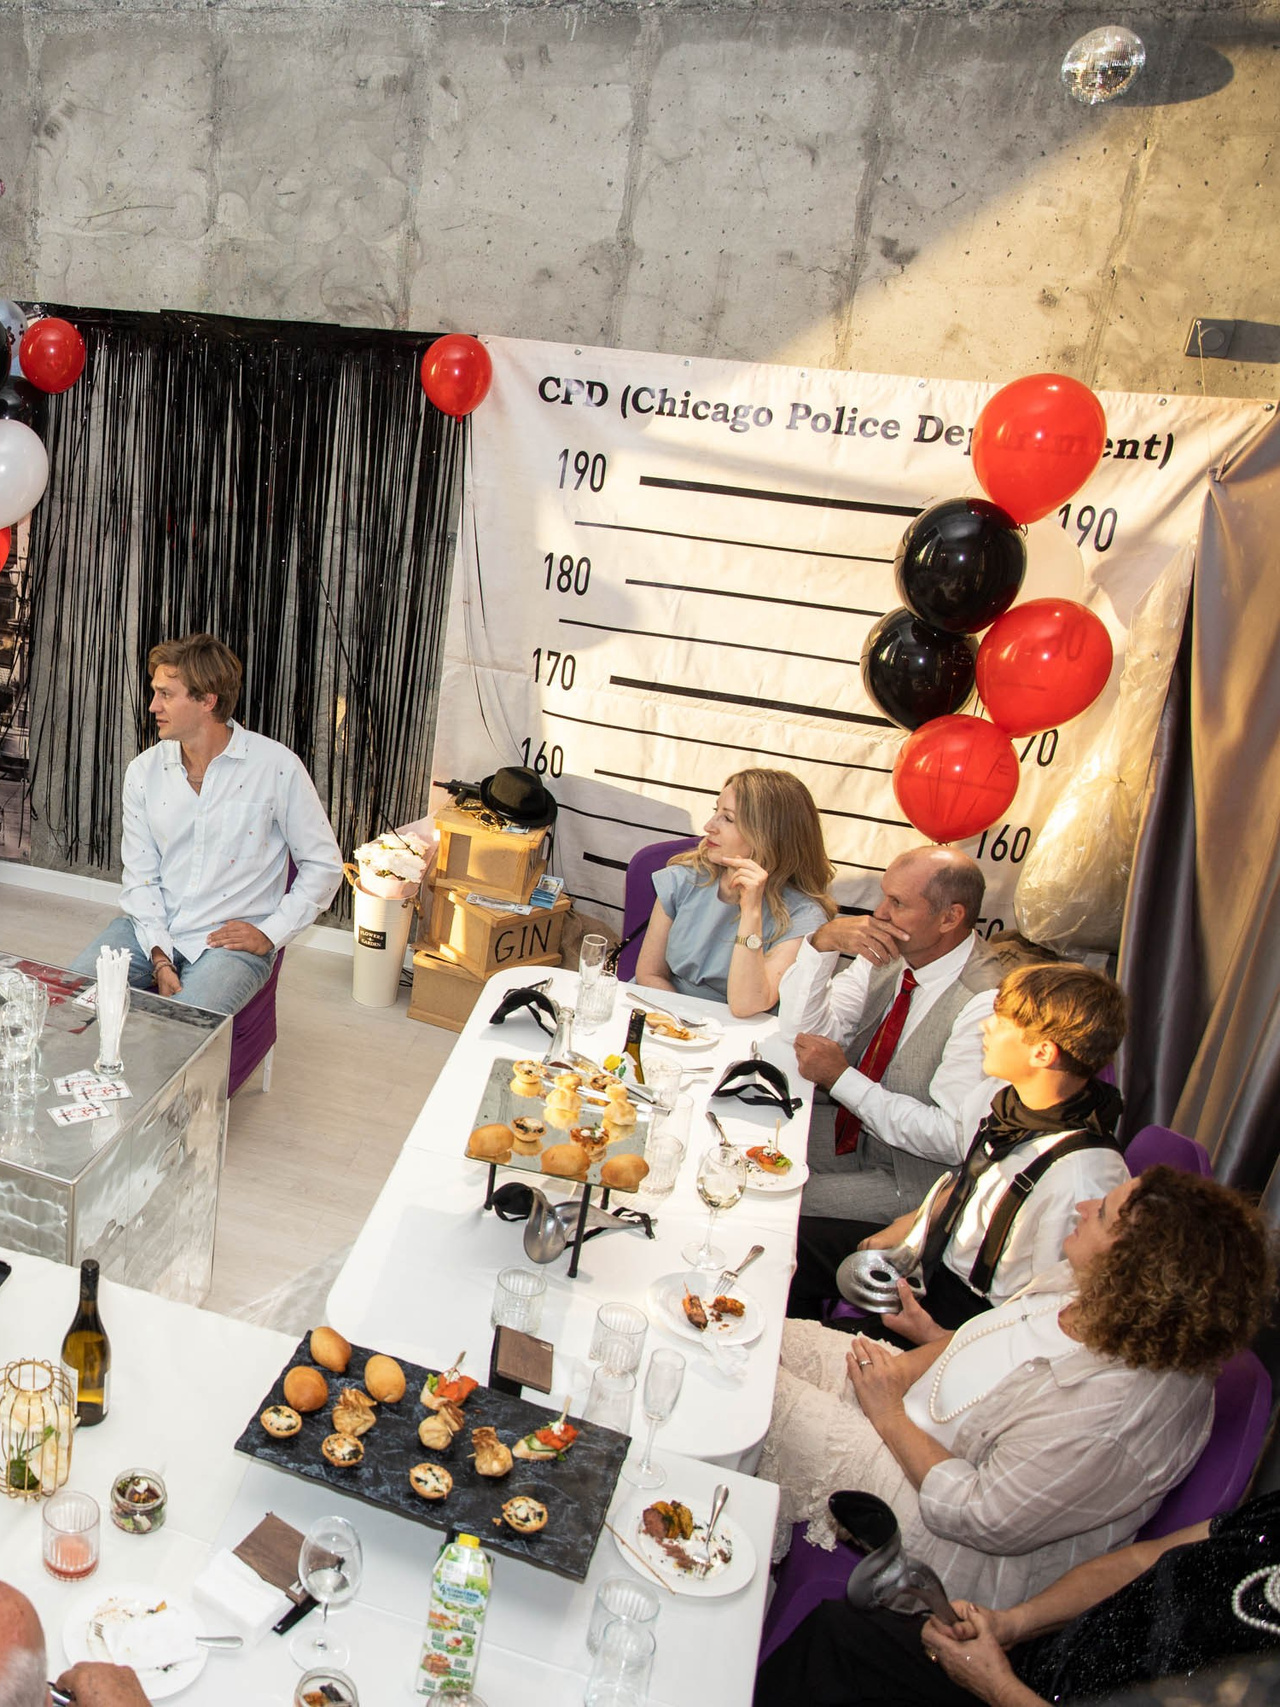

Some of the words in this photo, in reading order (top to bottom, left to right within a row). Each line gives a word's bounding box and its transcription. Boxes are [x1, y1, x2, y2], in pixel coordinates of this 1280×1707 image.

[538, 376, 609, 408] CPD
[620, 384, 774, 433] (Chicago
[785, 402, 901, 440] Police
[557, 448, 607, 493] 190
[1058, 503, 1118, 553] 190
[544, 552, 592, 596] 180
[532, 647, 577, 691] 170
[521, 737, 564, 779] 160
[976, 824, 1031, 864] 160
[494, 918, 552, 963] GIN
